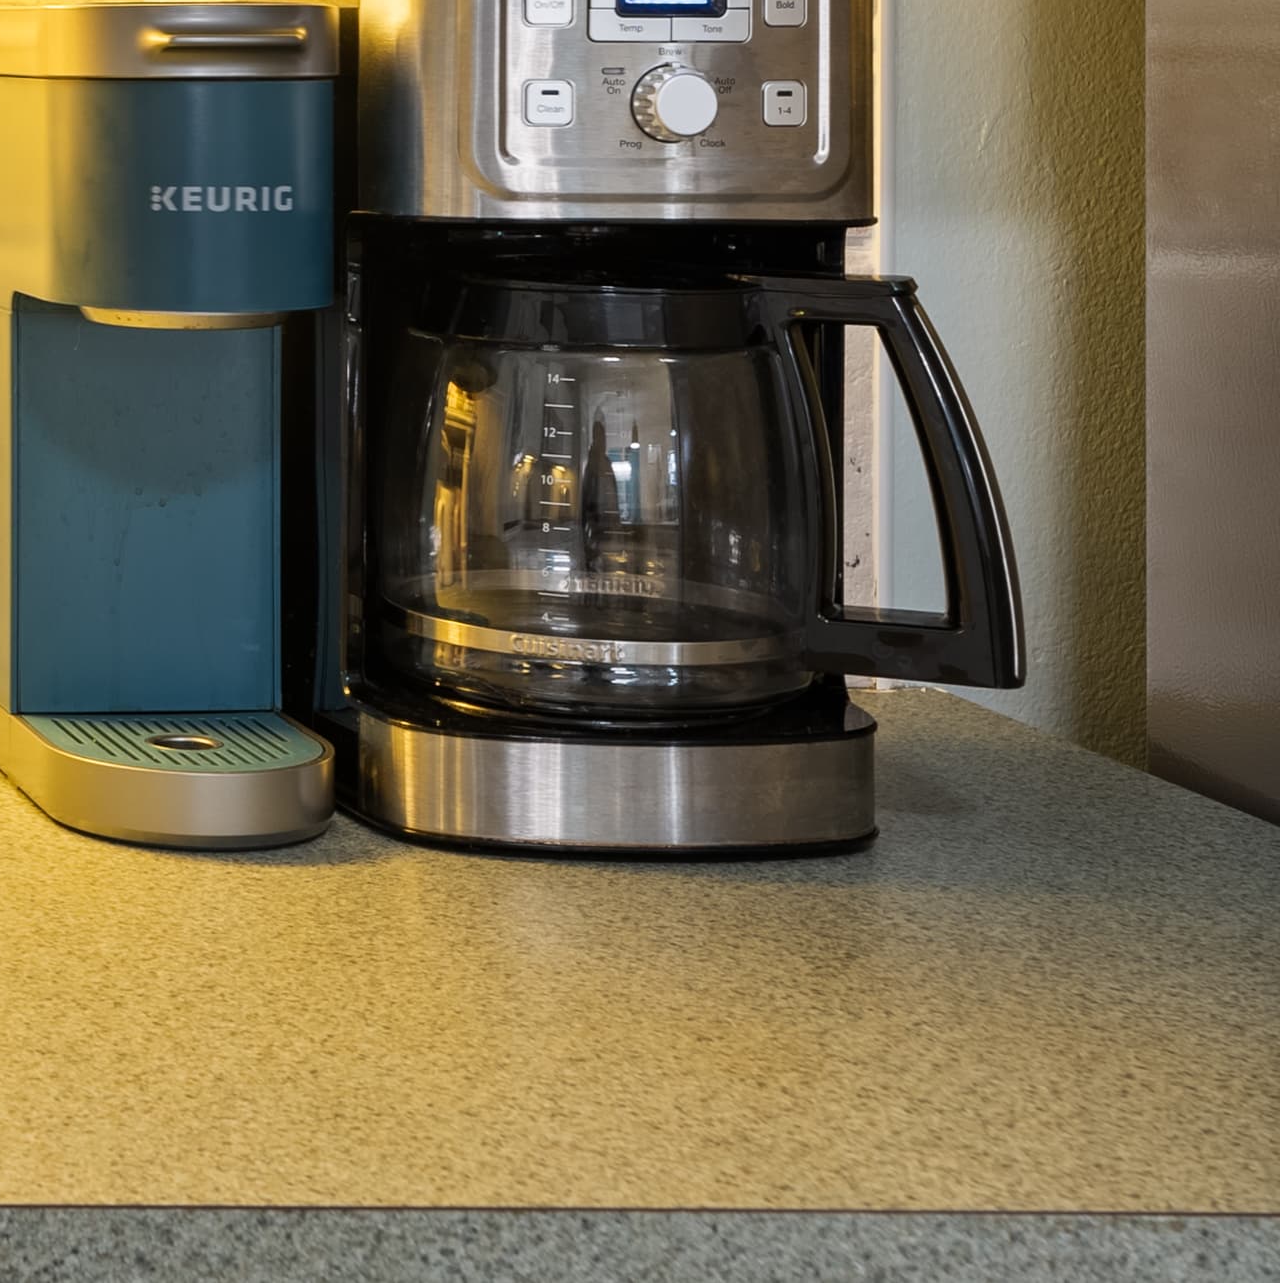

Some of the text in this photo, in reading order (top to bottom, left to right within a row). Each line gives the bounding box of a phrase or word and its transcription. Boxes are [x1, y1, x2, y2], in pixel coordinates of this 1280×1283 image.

[533, 0, 565, 9] On/Off
[776, 0, 795, 9] Bold
[619, 24, 644, 33] Temp
[702, 24, 723, 33] Tone
[658, 47, 683, 56] Brew
[602, 77, 626, 86] Auto
[714, 77, 736, 86] Auto
[606, 86, 621, 95] On
[718, 85, 732, 94] Off
[536, 104, 565, 113] Clean
[778, 106, 792, 115] 1-4
[619, 139, 642, 150] Prog
[699, 138, 726, 148] Clock
[150, 185, 293, 212] KEURIG
[547, 373, 560, 384] 14
[543, 427, 556, 438] 12
[541, 475, 554, 486] 10
[542, 522, 550, 533] 8
[542, 566, 550, 577] 6
[541, 612, 550, 622] 4
[509, 634, 626, 661] Cuisinart
